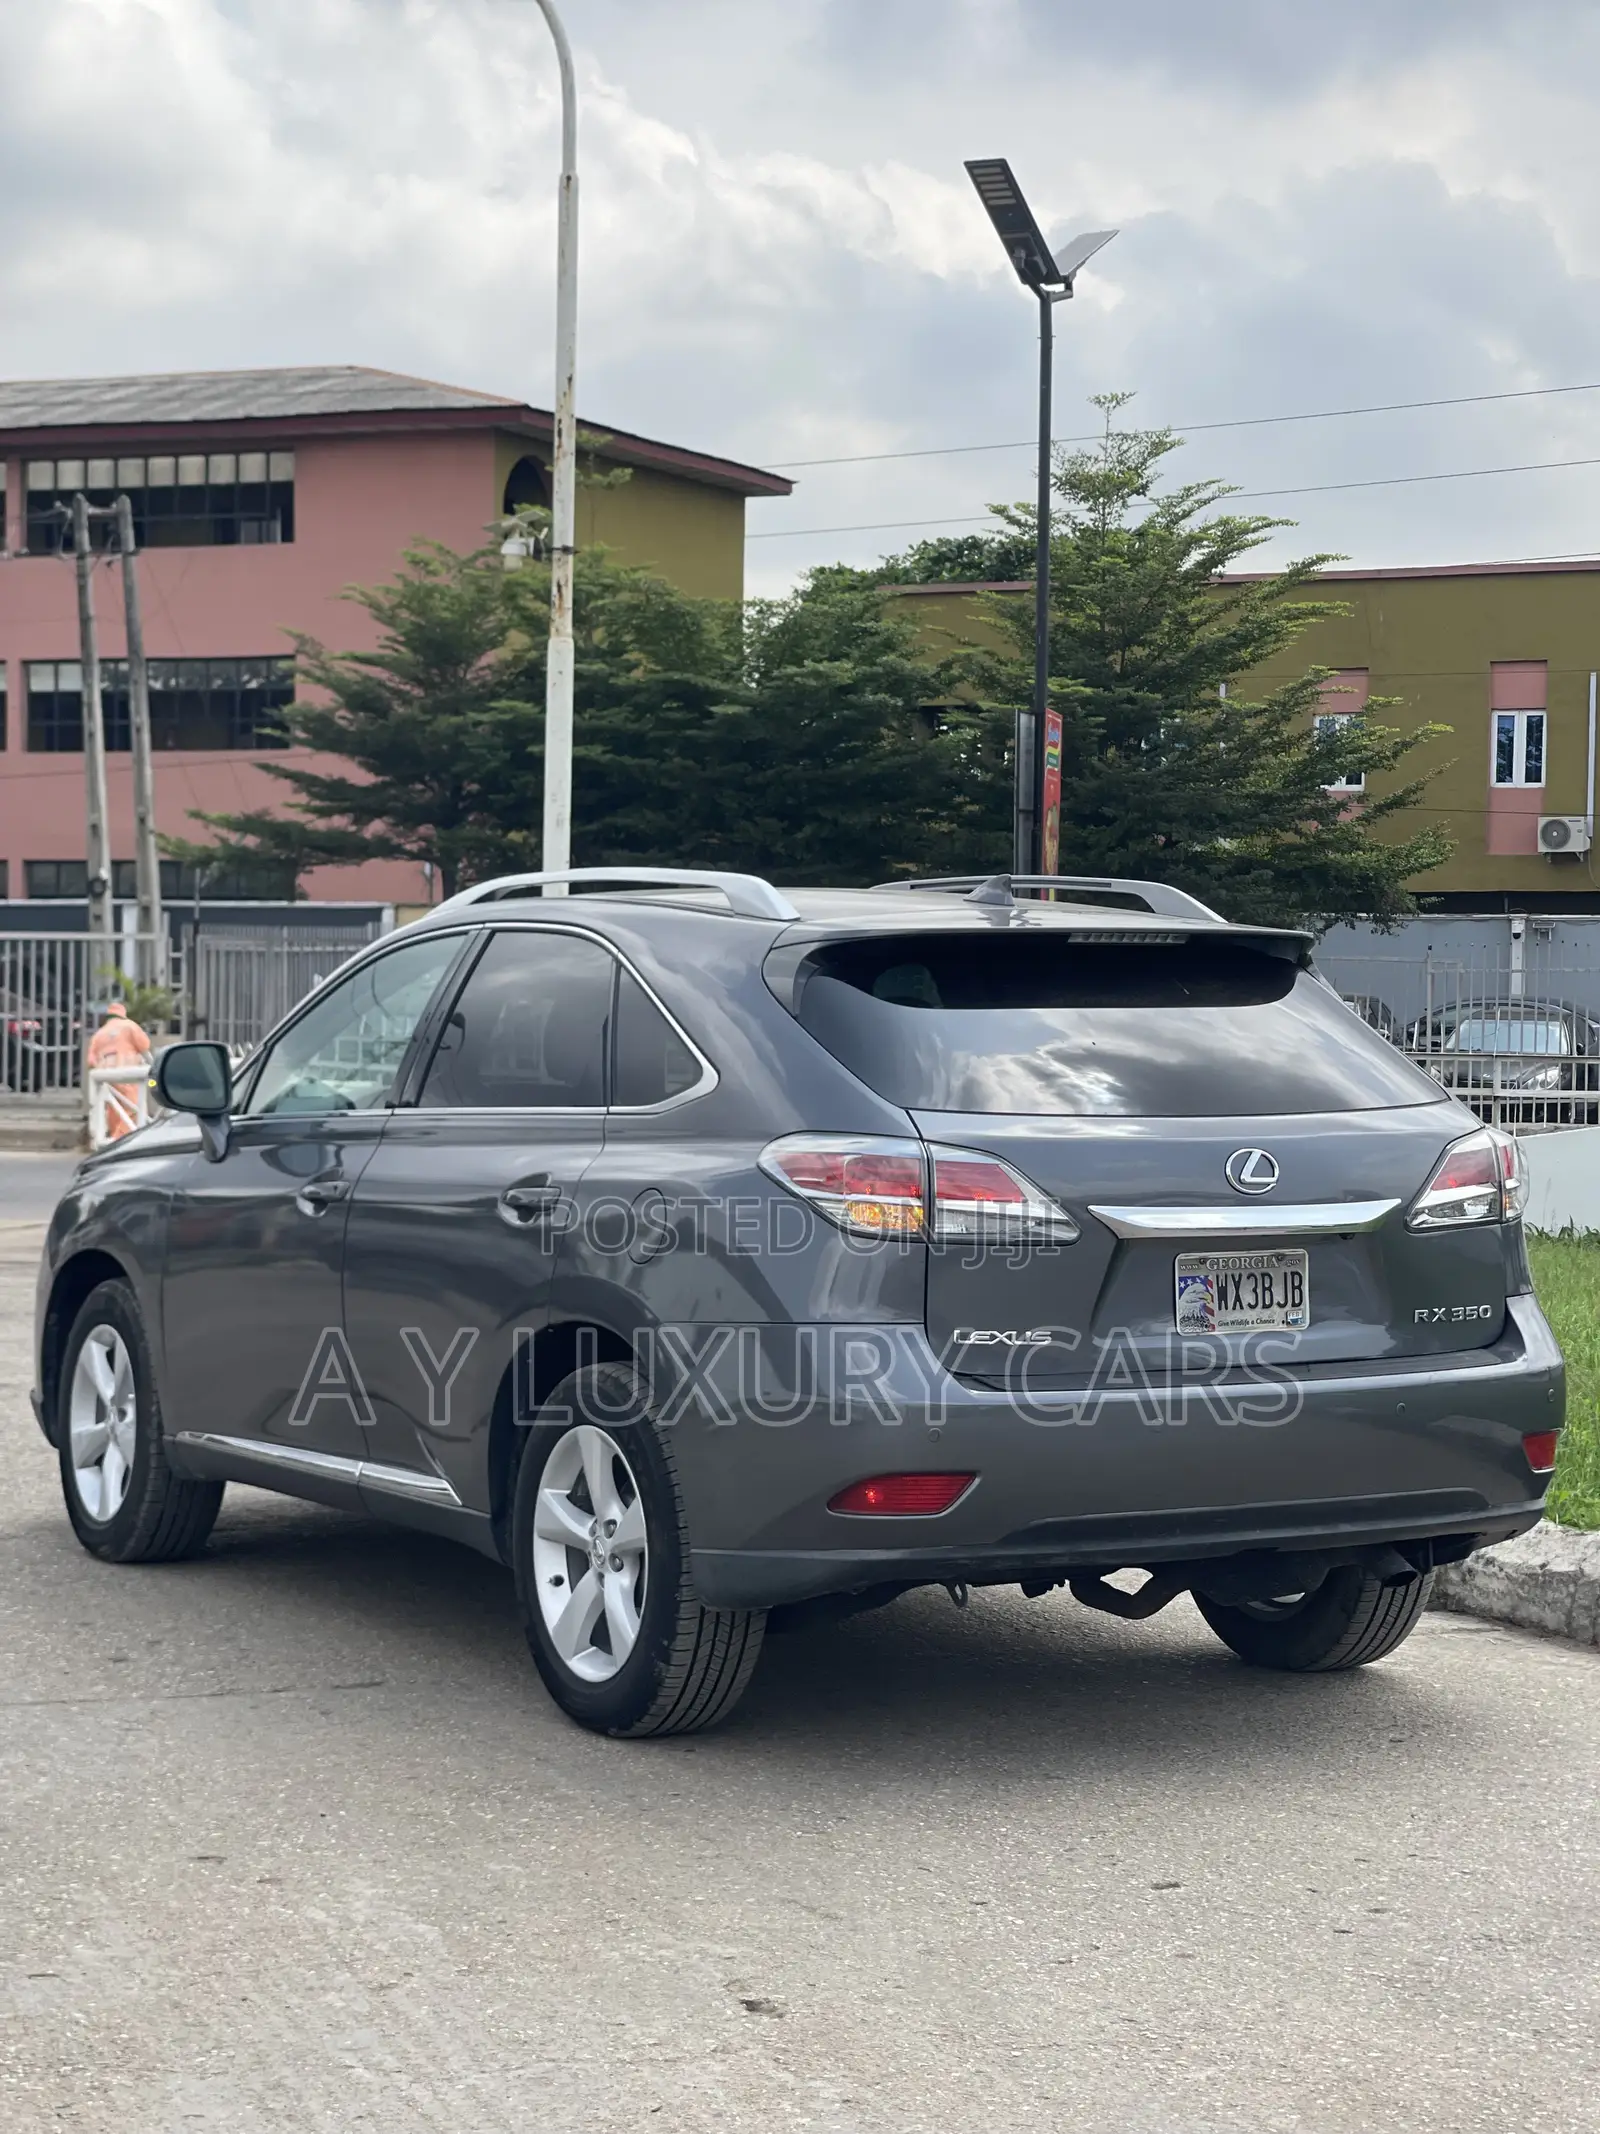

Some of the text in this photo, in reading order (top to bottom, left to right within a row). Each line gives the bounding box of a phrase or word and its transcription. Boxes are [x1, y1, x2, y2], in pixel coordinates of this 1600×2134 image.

[1206, 1255, 1279, 1270] GEORGIA
[1215, 1271, 1304, 1311] WX3BJB
[1414, 1304, 1492, 1323] RX 350
[1230, 1318, 1250, 1327] Wildlife
[1256, 1317, 1275, 1325] Chance
[953, 1329, 1052, 1345] LEXUS
